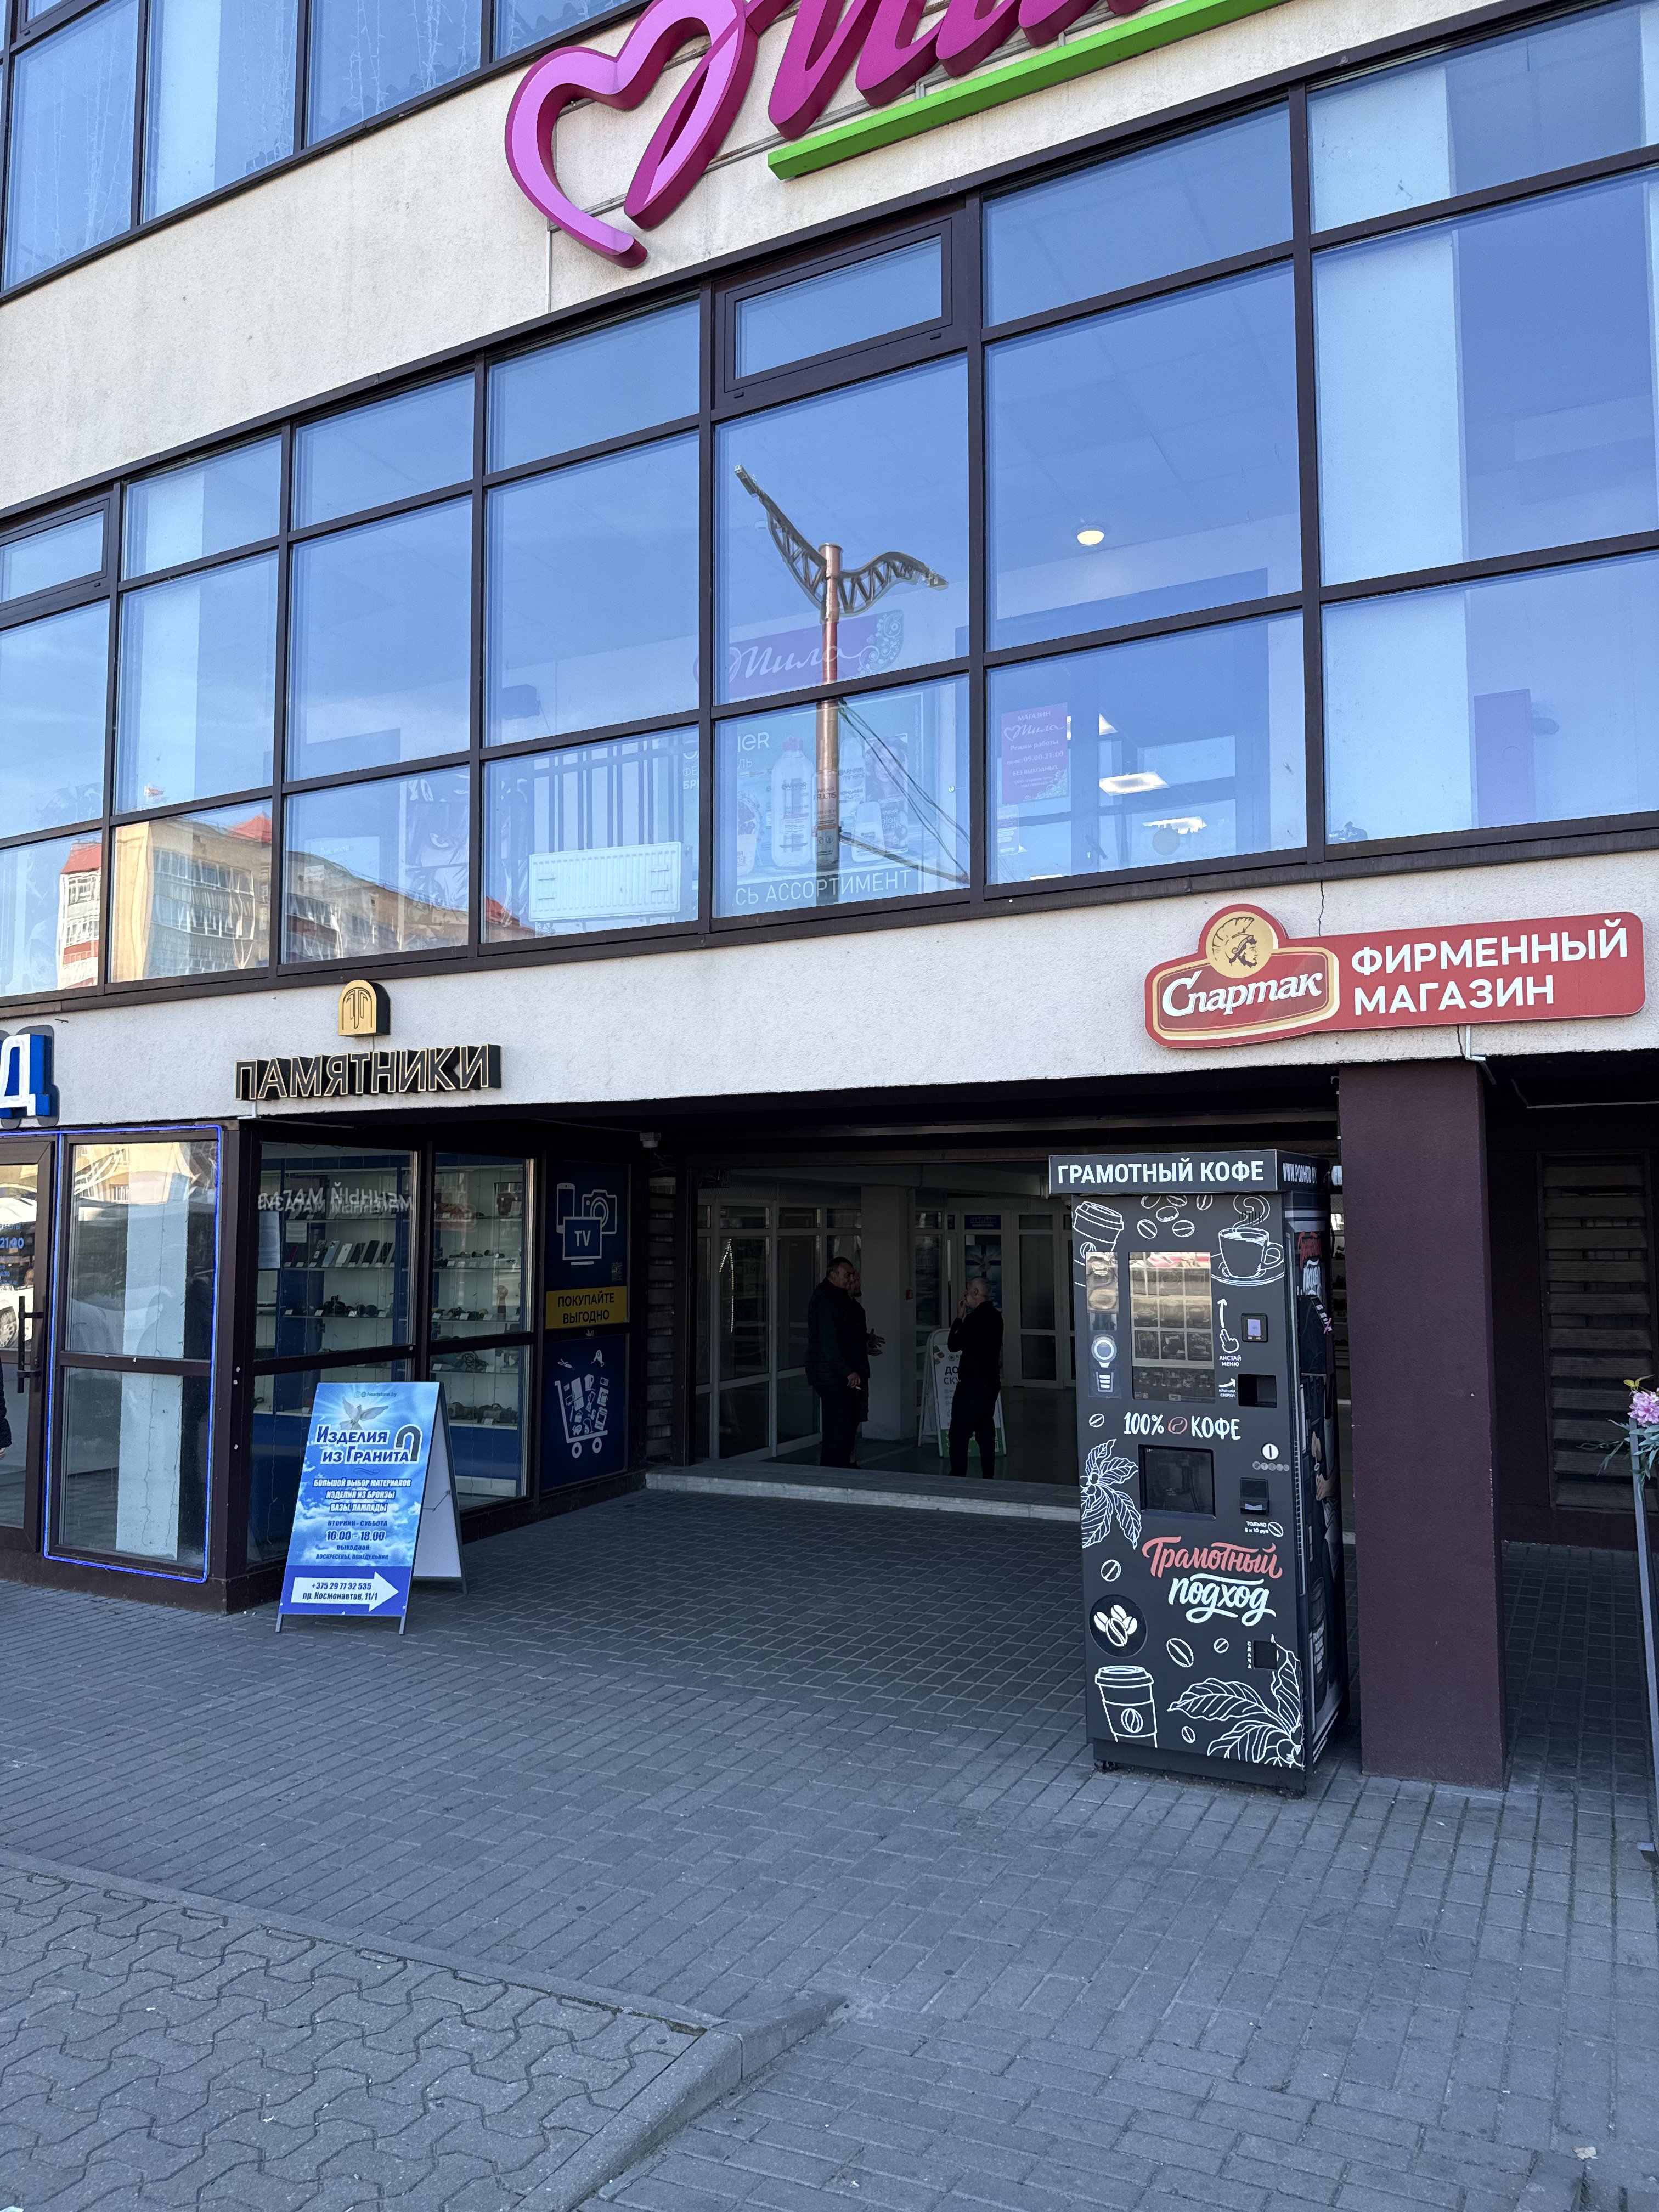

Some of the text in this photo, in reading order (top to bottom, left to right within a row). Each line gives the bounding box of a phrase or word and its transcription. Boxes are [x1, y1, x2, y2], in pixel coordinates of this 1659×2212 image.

[1018, 711, 1051, 721] МАГАЗИН
[1034, 740, 1058, 750] работы
[765, 869, 911, 903] АССОРТИМЕНТ
[1352, 918, 1628, 977] ФИРМЕННЫЙ
[1162, 970, 1323, 1017] Спартак
[1355, 976, 1554, 1015] МАГАЗИН
[236, 1044, 496, 1101] ПАМЯТНИКИ
[1058, 1158, 1264, 1184] ГРАМОТНЫЙ КОФЕ
[574, 1229, 591, 1246] TV
[558, 1290, 614, 1307] ПОКУПАЙТЕ
[563, 1310, 610, 1324] ВЫГОДНО
[1124, 1412, 1242, 1440] 100% КОФЕ
[316, 1426, 388, 1445] Изделия
[323, 1446, 409, 1463] из Гранита
[313, 1477, 346, 1487] БОЛЬШОЙ
[370, 1479, 411, 1487] МАТЕРИАЛОВ
[326, 1491, 396, 1499] ИЗДЕЛИЯ ИЗ БРОНЗЫ
[330, 1503, 387, 1513] ВАЗЫ, ЛАМПАДЫ
[327, 1531, 352, 1541] 10.00
[360, 1531, 385, 1541] 18.00
[1142, 1536, 1283, 1579] Грамотный
[302, 1592, 378, 1601] пр. Космонавтов, 11/1
[1168, 1573, 1277, 1627] подход
